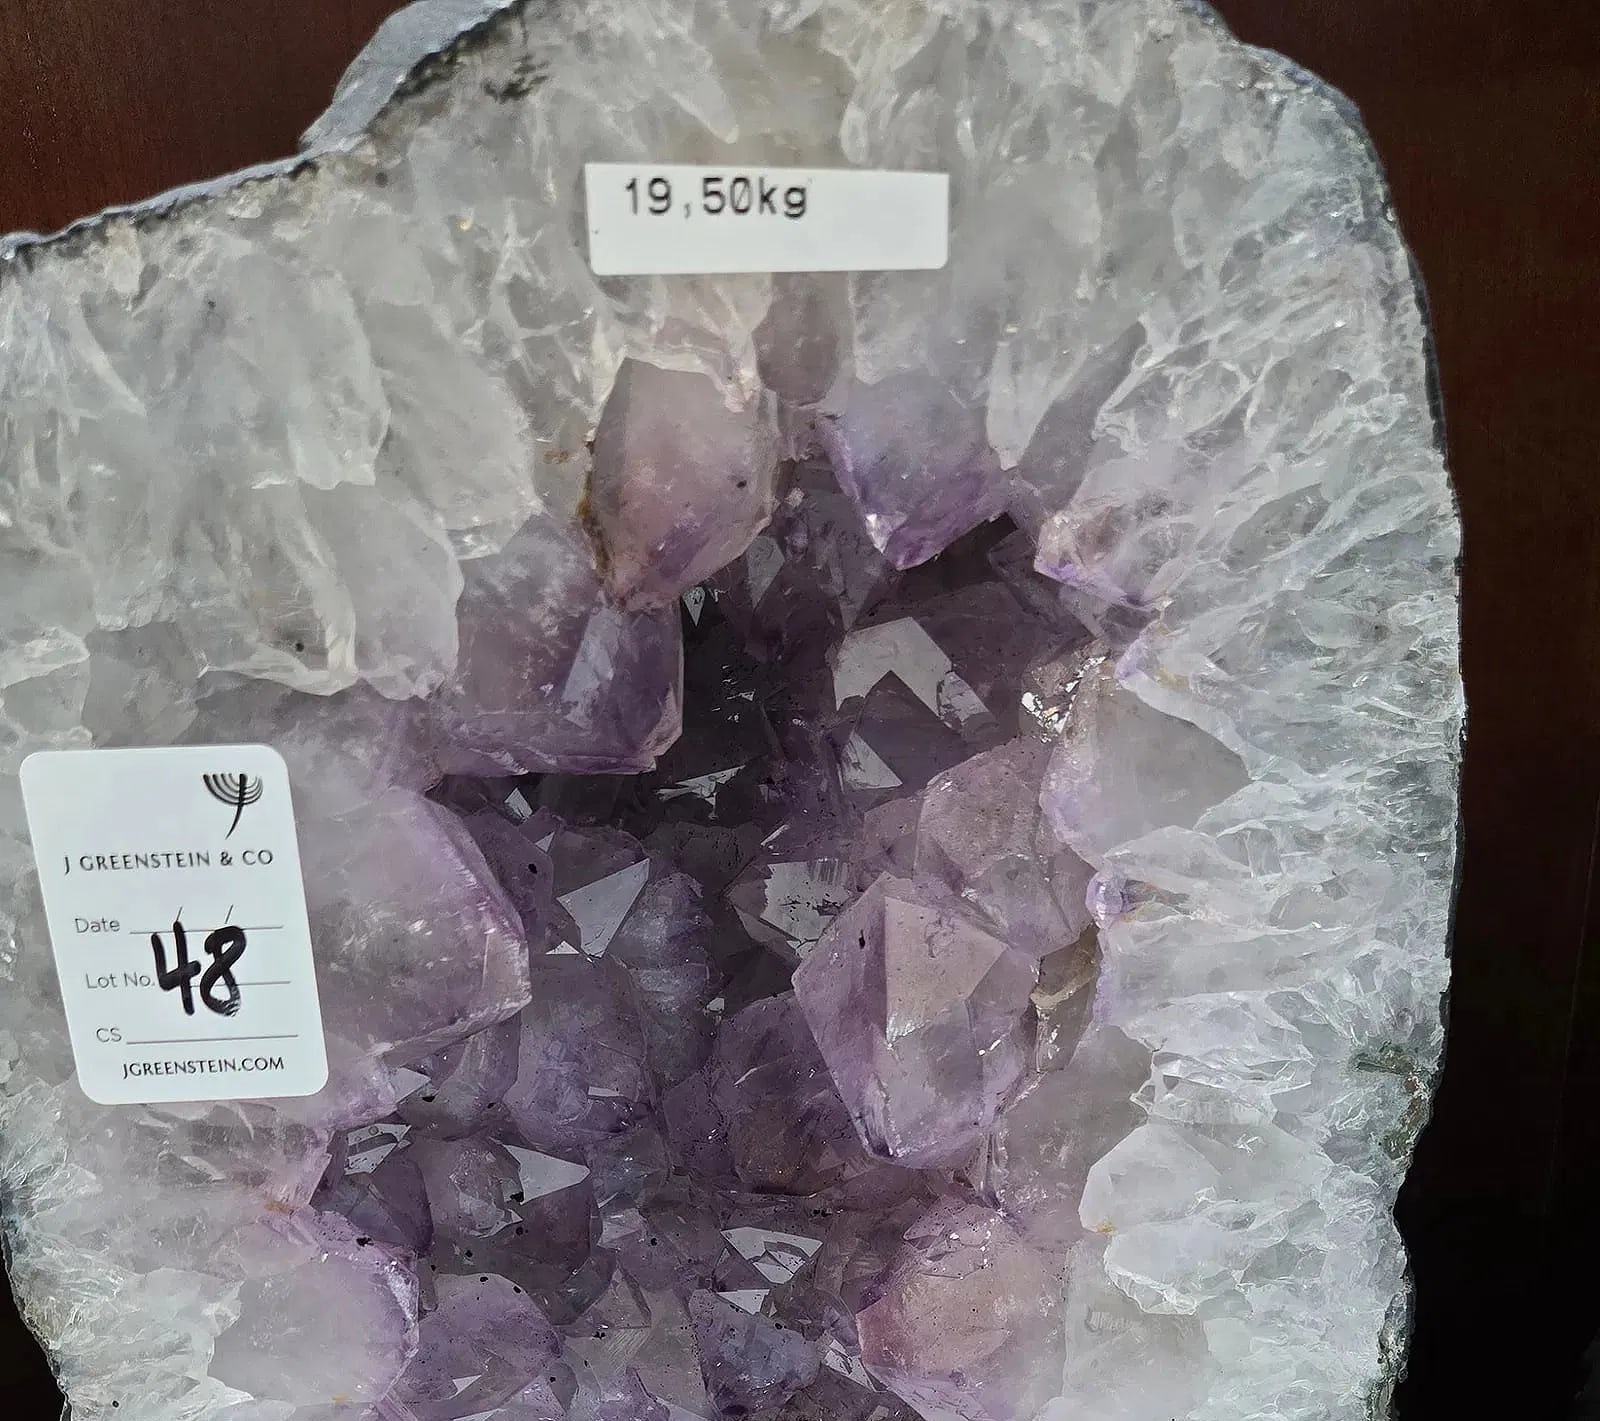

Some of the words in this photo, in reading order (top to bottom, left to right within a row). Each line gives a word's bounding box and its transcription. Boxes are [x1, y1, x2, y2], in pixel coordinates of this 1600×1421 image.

[624, 175, 808, 219] 19,50kg
[64, 854, 71, 876] J
[79, 851, 211, 872] GREENSTEIN
[220, 850, 233, 867] &
[242, 849, 275, 866] CO
[75, 917, 121, 934] Date
[150, 920, 248, 1017] 48
[85, 973, 118, 989] Lot
[96, 1027, 122, 1043] CS
[122, 1056, 285, 1080] JGREENSTEIN.COM
